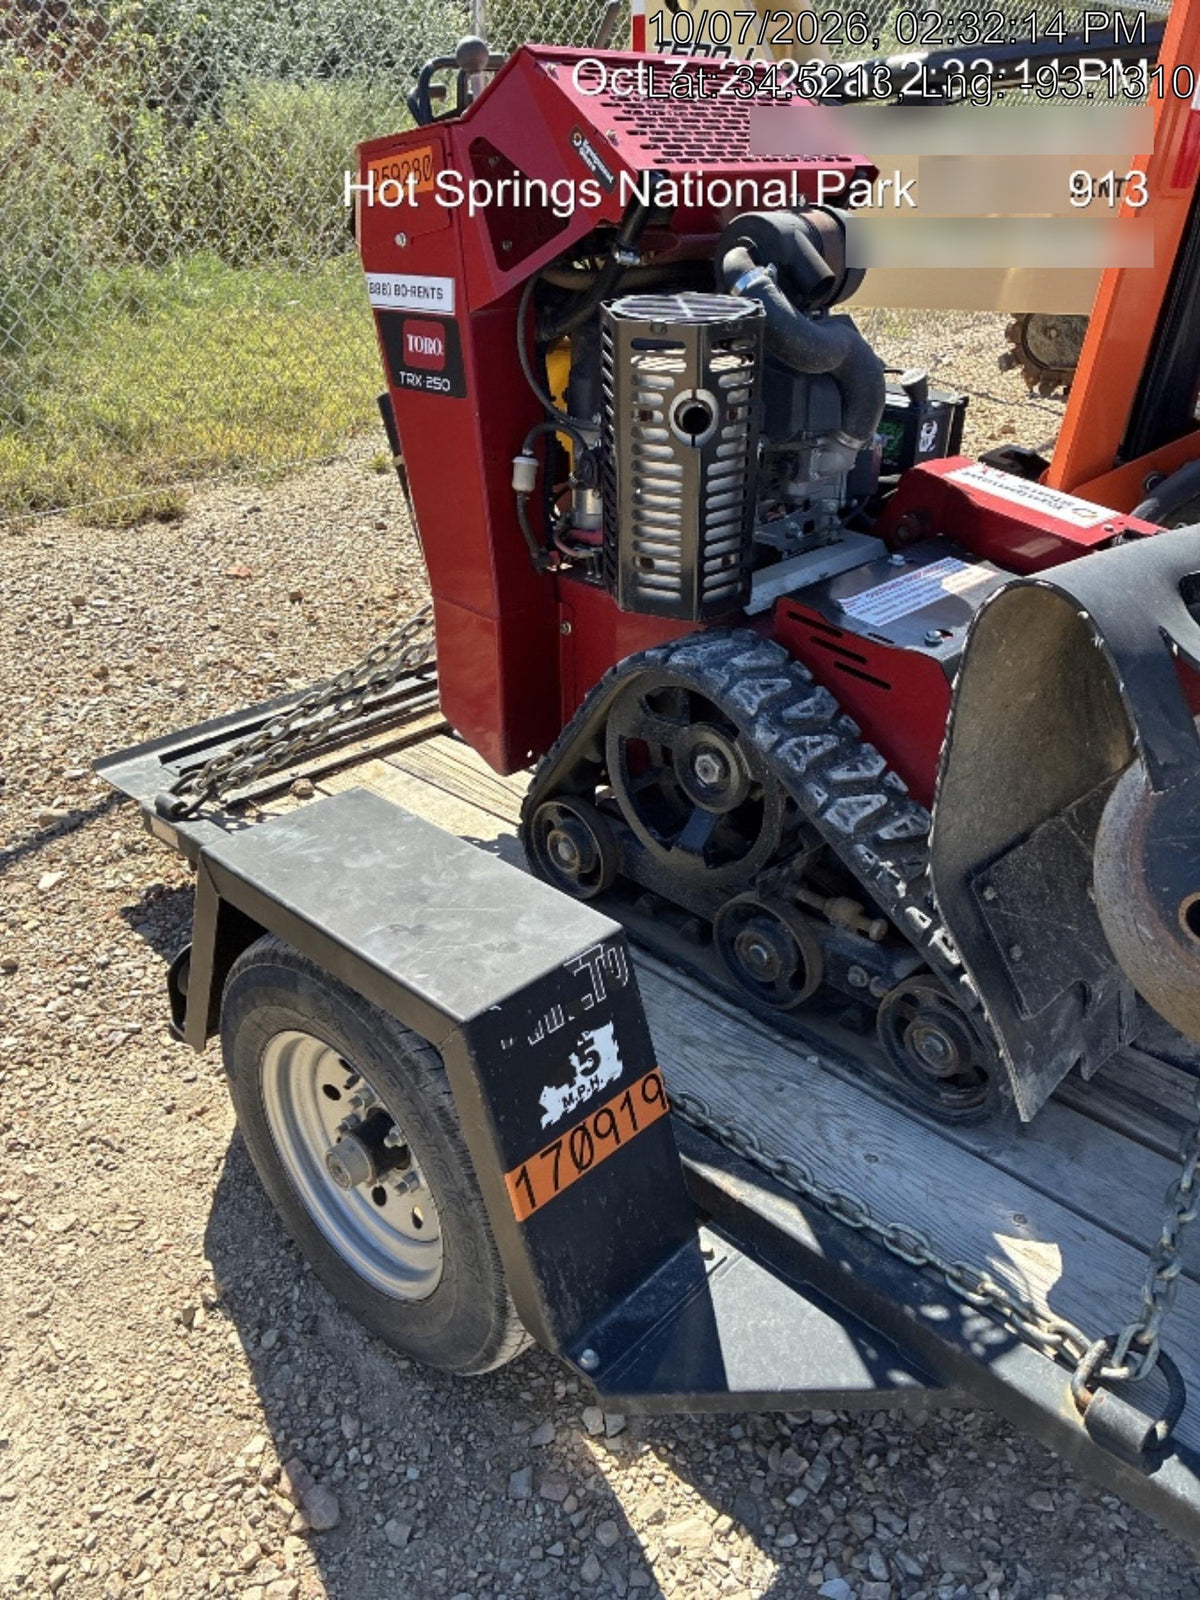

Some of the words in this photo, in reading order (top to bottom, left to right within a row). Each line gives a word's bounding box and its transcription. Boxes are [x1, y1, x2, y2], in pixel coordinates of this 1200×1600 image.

[394, 283, 444, 301] 80-RENTS
[406, 333, 444, 357] TORO
[398, 371, 452, 393] TRX-250
[514, 1072, 668, 1210] 170919
